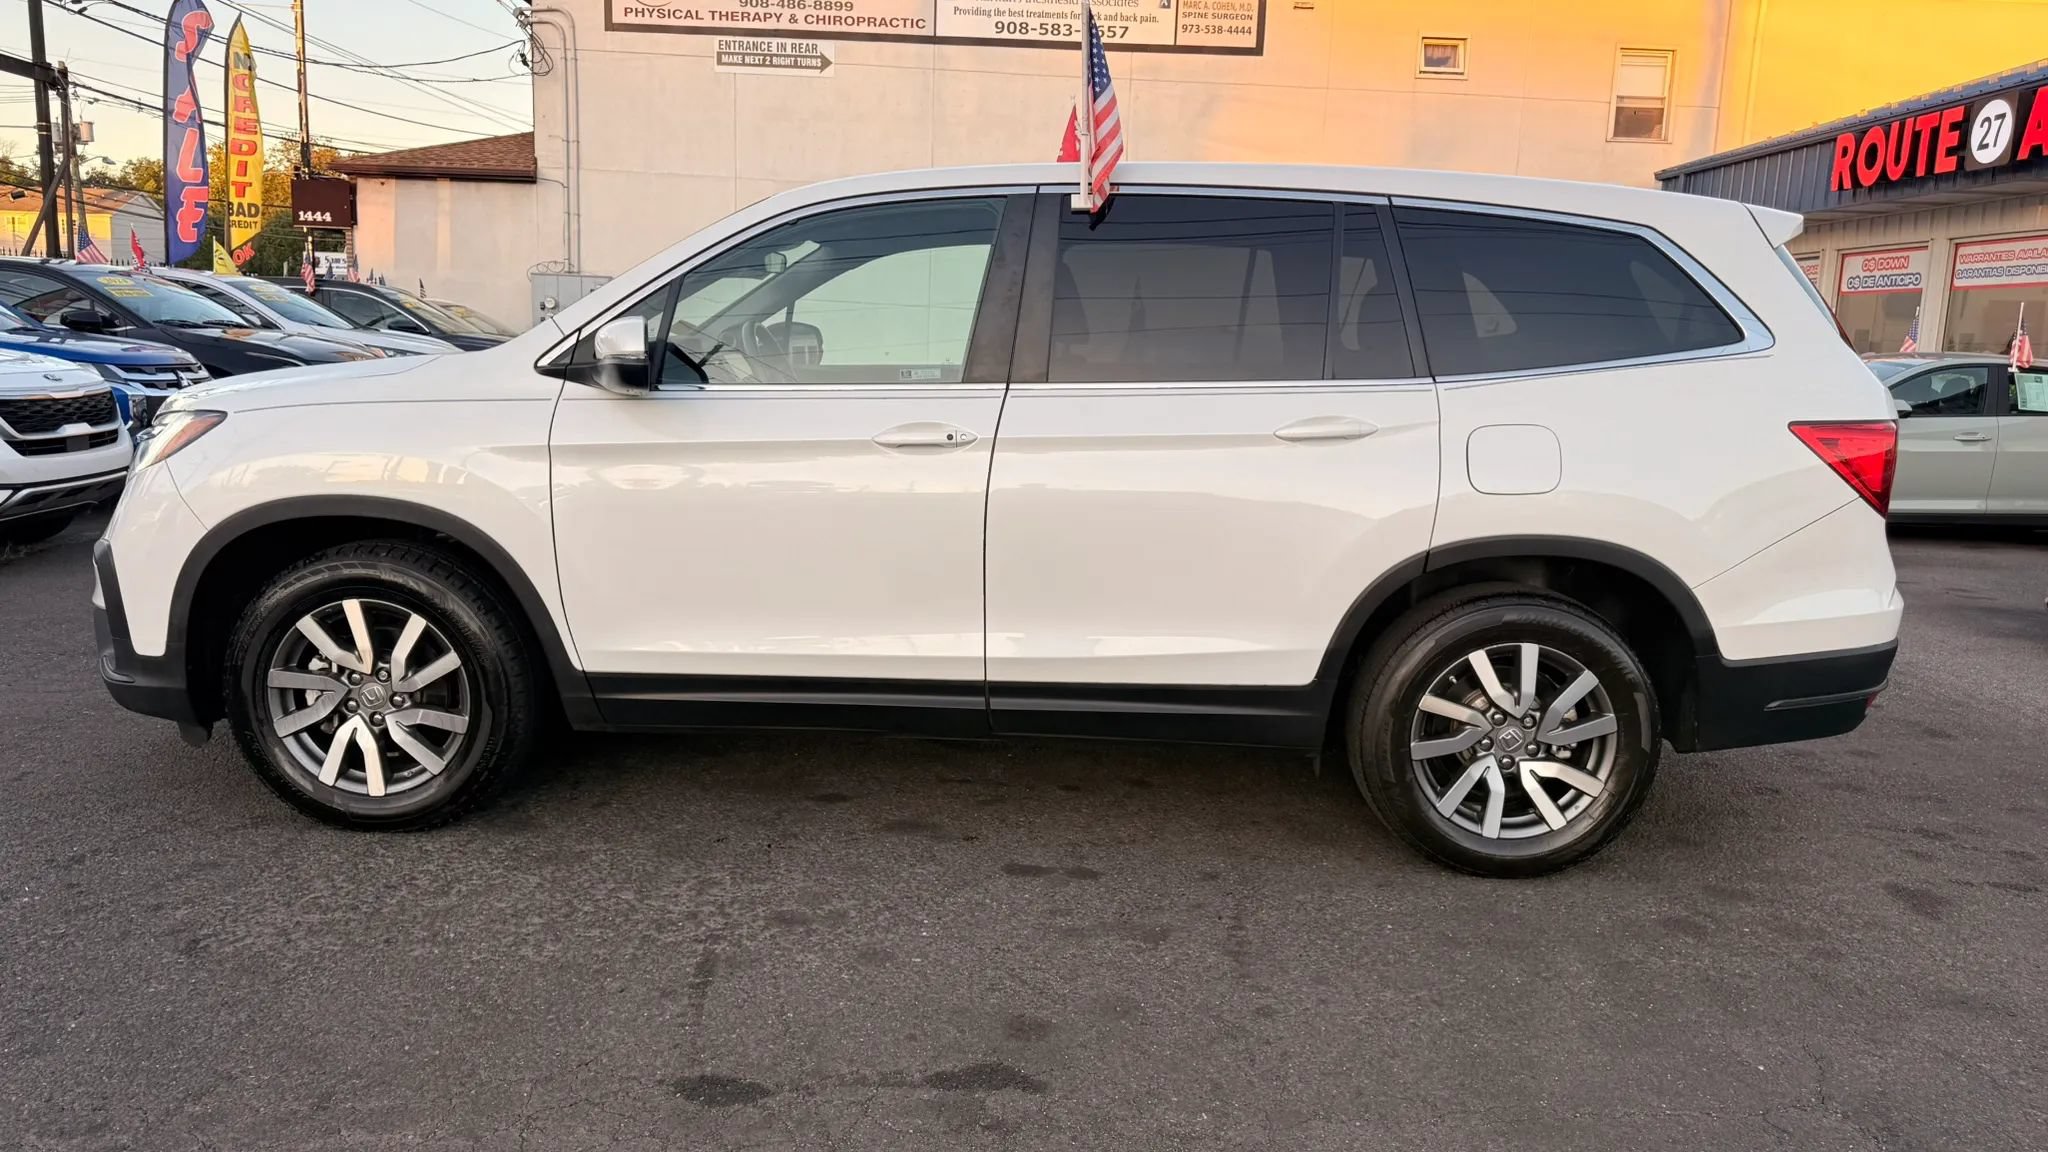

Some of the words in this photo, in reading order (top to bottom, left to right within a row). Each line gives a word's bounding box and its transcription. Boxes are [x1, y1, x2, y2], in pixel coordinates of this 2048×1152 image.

[739, 0, 853, 12] 908-486-8899
[1183, 1, 1202, 10] MARC
[1203, 2, 1210, 10] A.
[624, 7, 705, 21] PHYSICAL
[709, 10, 783, 23] THERAPY
[788, 13, 799, 25] &
[804, 14, 926, 29] CHIROPRACTIC
[953, 6, 992, 18] Providing
[993, 8, 1006, 17] the
[1008, 9, 1024, 18] best
[1026, 10, 1068, 20] treatments
[1070, 10, 1081, 20] for
[1103, 12, 1118, 22] and
[1120, 13, 1138, 22] back
[1140, 13, 1159, 24] pain.
[1182, 11, 1209, 20] SPINE
[1211, 12, 1253, 21] SURGEON
[1182, 24, 1252, 35] 973-538-4444
[718, 39, 773, 53] ENTRANCE
[776, 41, 787, 53] IN
[790, 43, 818, 54] REAR
[721, 54, 743, 64] MAKE
[745, 55, 764, 65] NEXT
[765, 56, 771, 65] 2
[773, 57, 795, 66] RIGHT
[797, 58, 821, 67] TURNS
[1831, 105, 1965, 192] ROUTE
[1976, 112, 2007, 151] 27
[228, 202, 260, 218] BAD
[298, 210, 332, 222] 1444
[232, 242, 255, 266] OK
[1959, 249, 2015, 265] WARRANTIES
[1877, 255, 1910, 272] DOWN
[1954, 266, 2004, 279] GARANTIAS
[1862, 275, 1877, 288] DE
[1876, 272, 1922, 287] ANTICIPO
